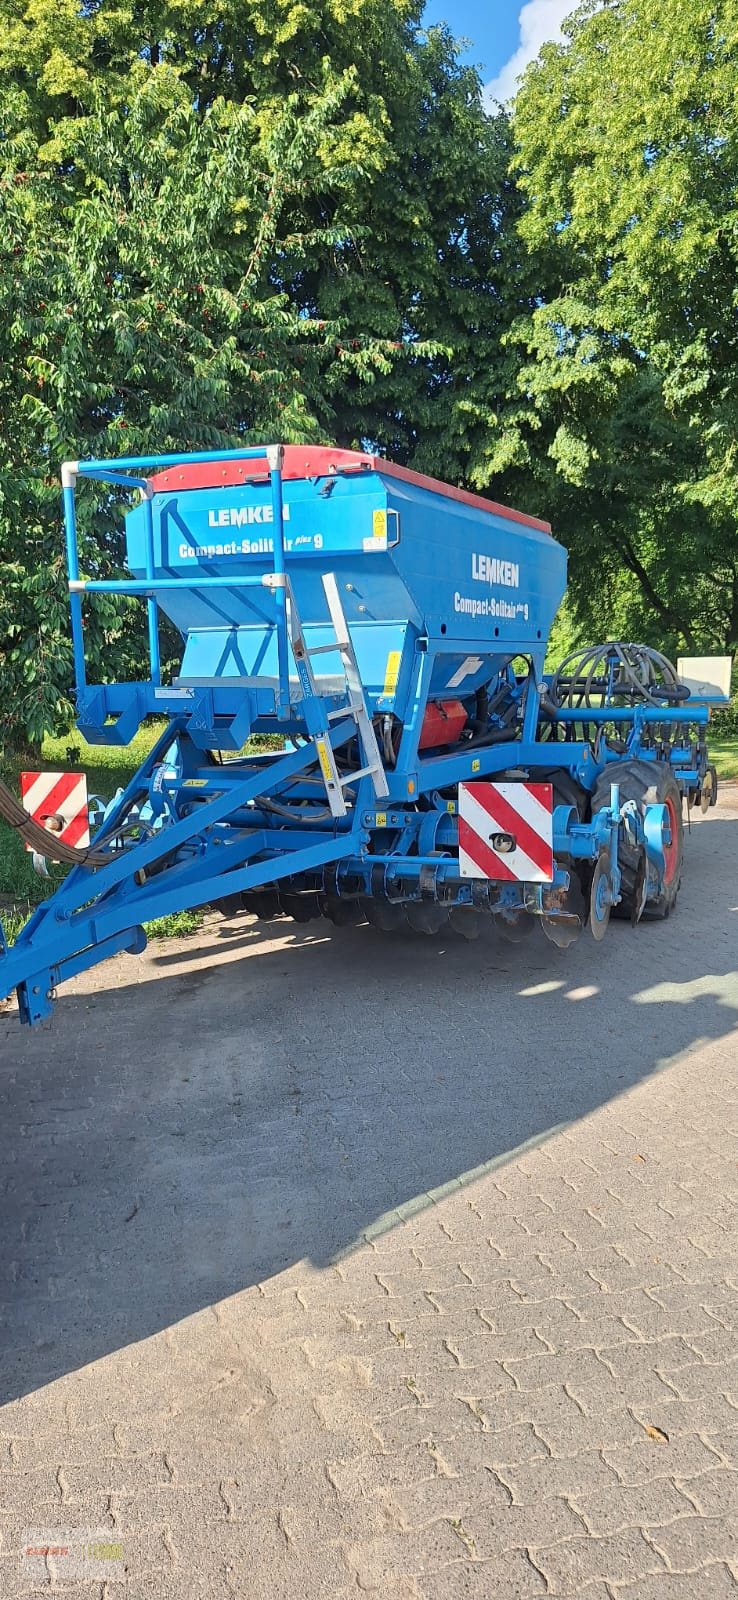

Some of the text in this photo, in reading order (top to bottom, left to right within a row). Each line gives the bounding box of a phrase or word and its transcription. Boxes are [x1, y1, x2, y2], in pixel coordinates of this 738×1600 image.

[179, 536, 293, 558] Compact-Solitir
[313, 533, 323, 549] 9
[472, 553, 519, 588] LEMKEN
[454, 592, 516, 618] Compact-Solitair
[524, 603, 529, 620] 9
